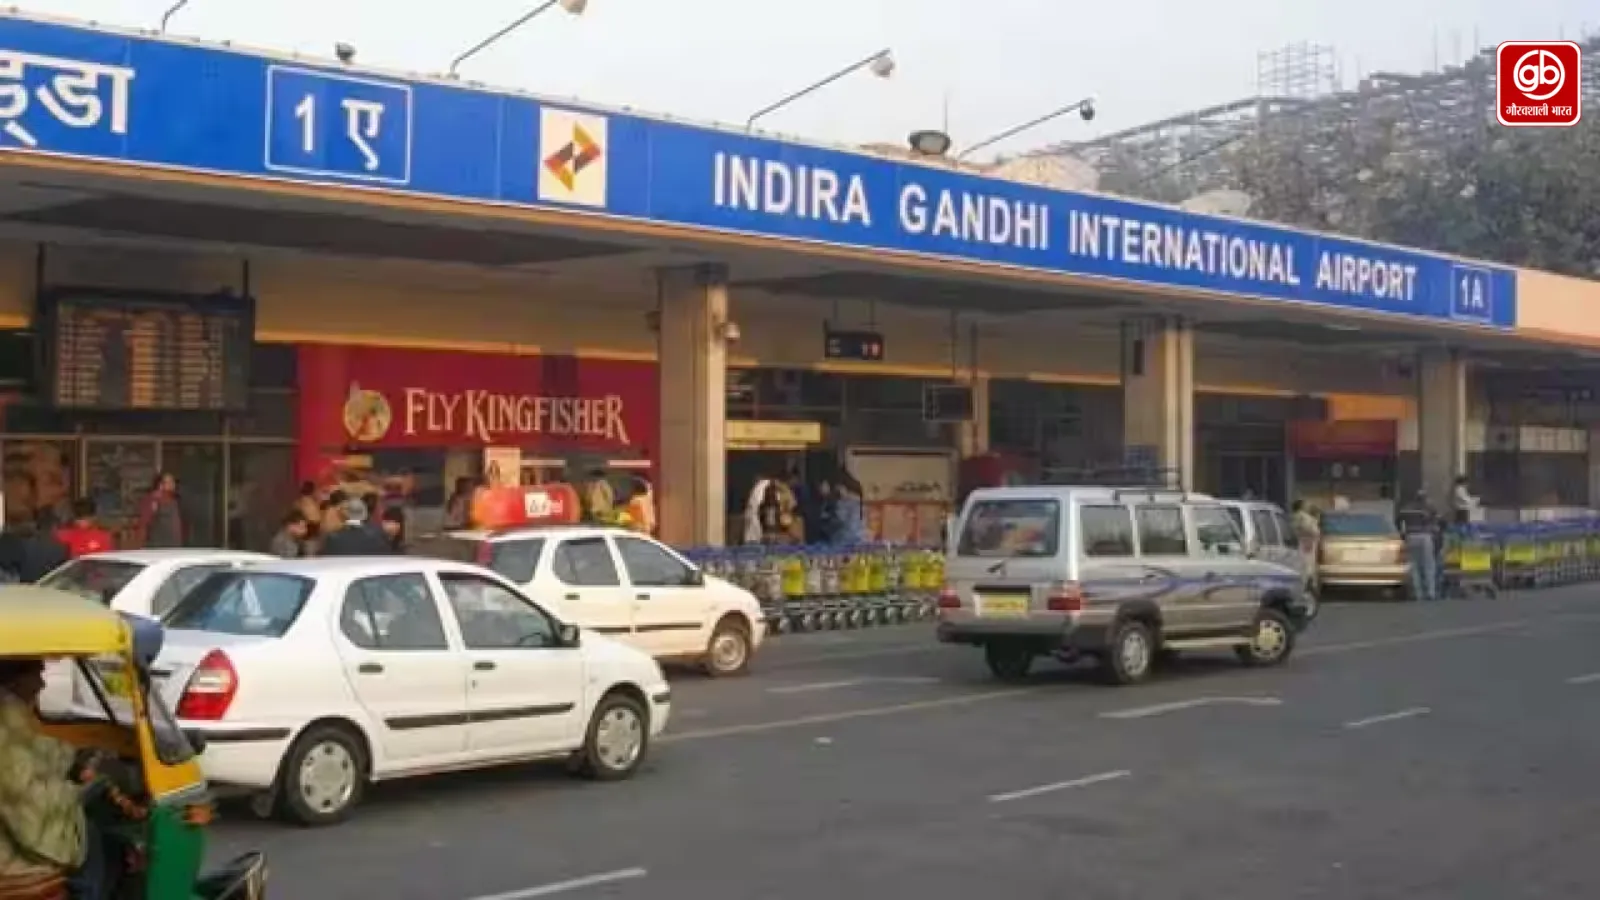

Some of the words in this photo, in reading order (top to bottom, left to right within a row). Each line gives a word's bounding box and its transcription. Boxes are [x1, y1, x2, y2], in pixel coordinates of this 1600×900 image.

[295, 94, 315, 152] 1
[341, 98, 385, 171] ए
[713, 151, 872, 226] INDIRA
[900, 184, 1049, 250] GANDHI
[1069, 209, 1300, 286] INTERNATIONAL
[1316, 250, 1417, 301] AIRPORT
[1460, 274, 1485, 309] 1A
[403, 386, 460, 436] FLY
[465, 388, 631, 445] KINGFISHER
